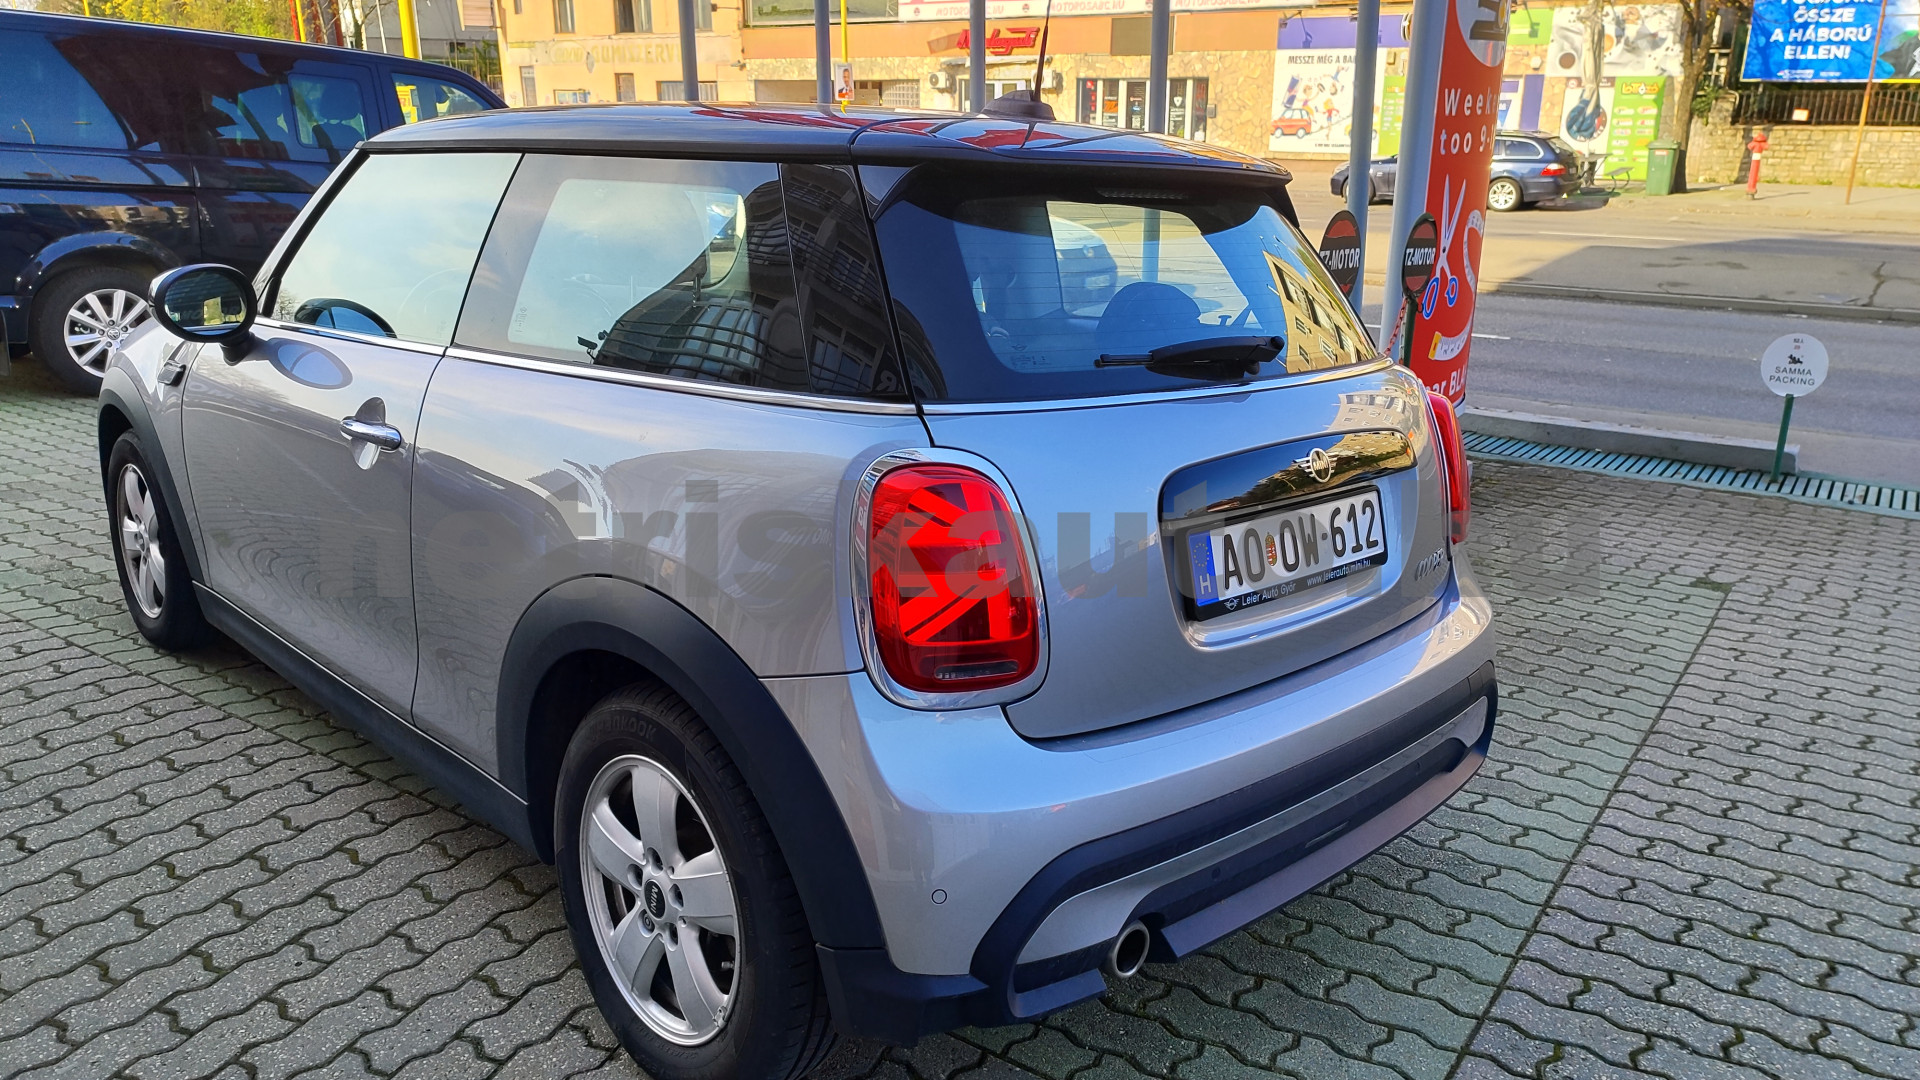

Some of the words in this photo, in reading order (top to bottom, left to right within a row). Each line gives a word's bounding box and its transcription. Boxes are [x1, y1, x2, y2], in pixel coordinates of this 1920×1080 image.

[1793, 6, 1856, 23] ÖSSZE
[1769, 28, 1784, 42] A
[1788, 24, 1873, 42] HÁBORÚ
[1287, 55, 1315, 65] MESSZE
[1316, 54, 1333, 65] MÉG
[1334, 55, 1341, 64] A
[1783, 45, 1851, 60] ELLEN!
[1439, 128, 1472, 156] too
[1404, 247, 1437, 267] TZ-MOTOR
[1774, 366, 1813, 376] SAMMA
[1768, 375, 1816, 386] PACKING
[1199, 573, 1212, 595] H
[1241, 593, 1261, 606] Leier
[1261, 587, 1279, 600] Autó
[1280, 582, 1297, 596] Győr
[1306, 558, 1371, 587] www.leierauto.mini.hu
[650, 885, 658, 914] MINI
